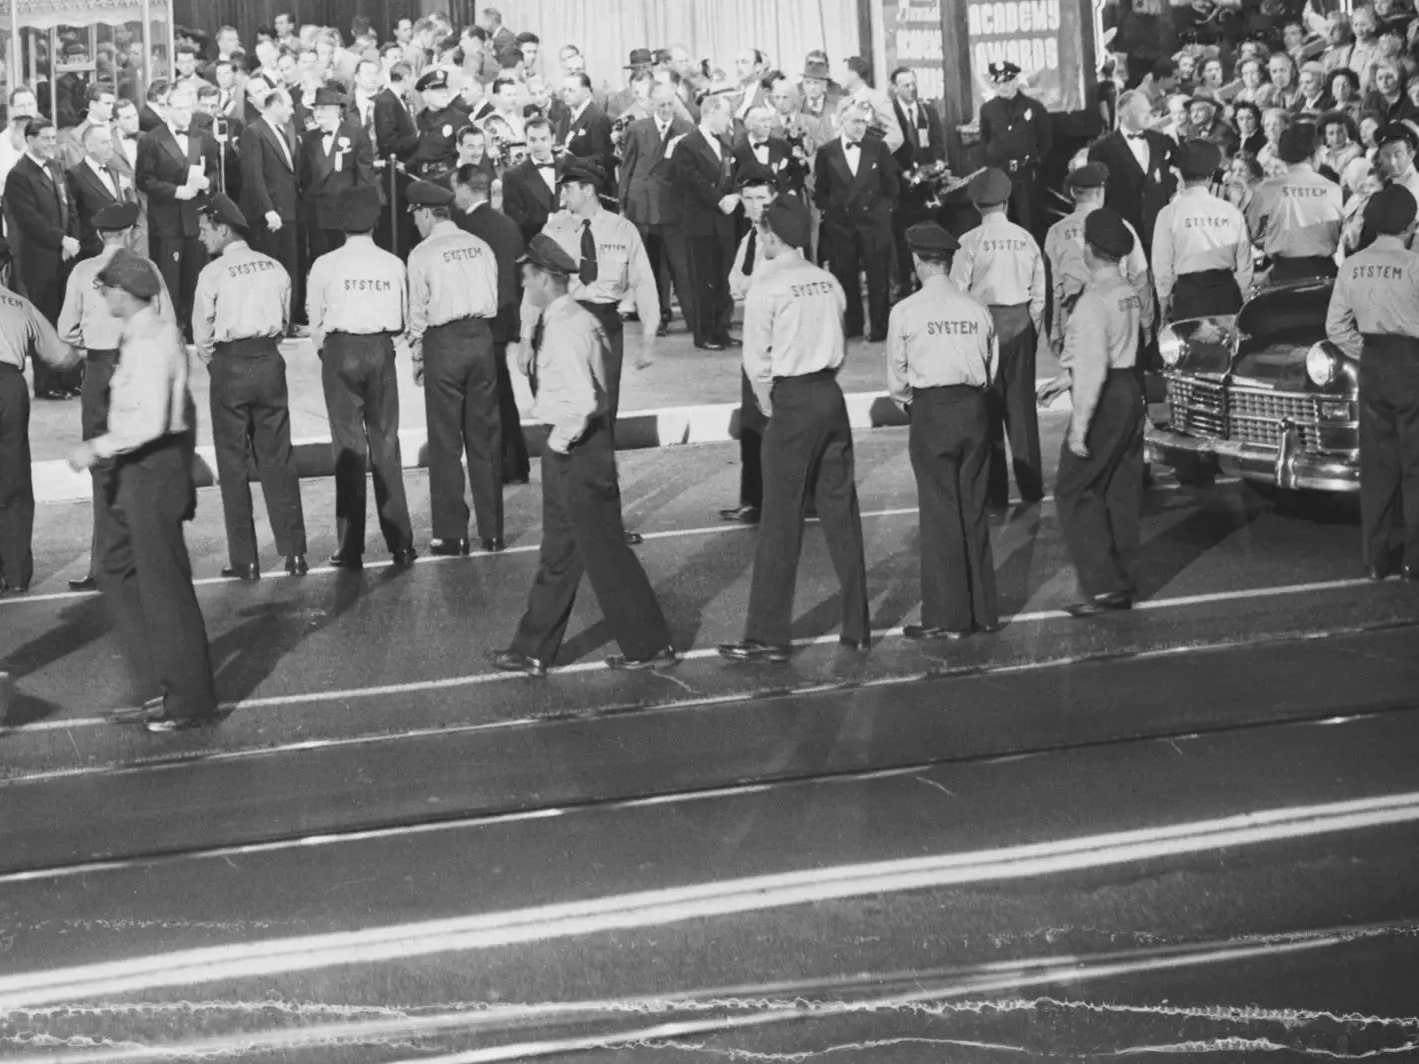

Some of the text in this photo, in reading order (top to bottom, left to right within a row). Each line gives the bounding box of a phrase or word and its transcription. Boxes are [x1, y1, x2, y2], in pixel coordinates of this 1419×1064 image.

[1282, 187, 1328, 199] SYSTEM
[982, 238, 1028, 253] SYSTEM
[442, 246, 483, 264] SYSTEM
[1352, 266, 1402, 281] SYSTEM
[344, 278, 391, 292] SYSTEM
[927, 320, 979, 336] SYSTEM
